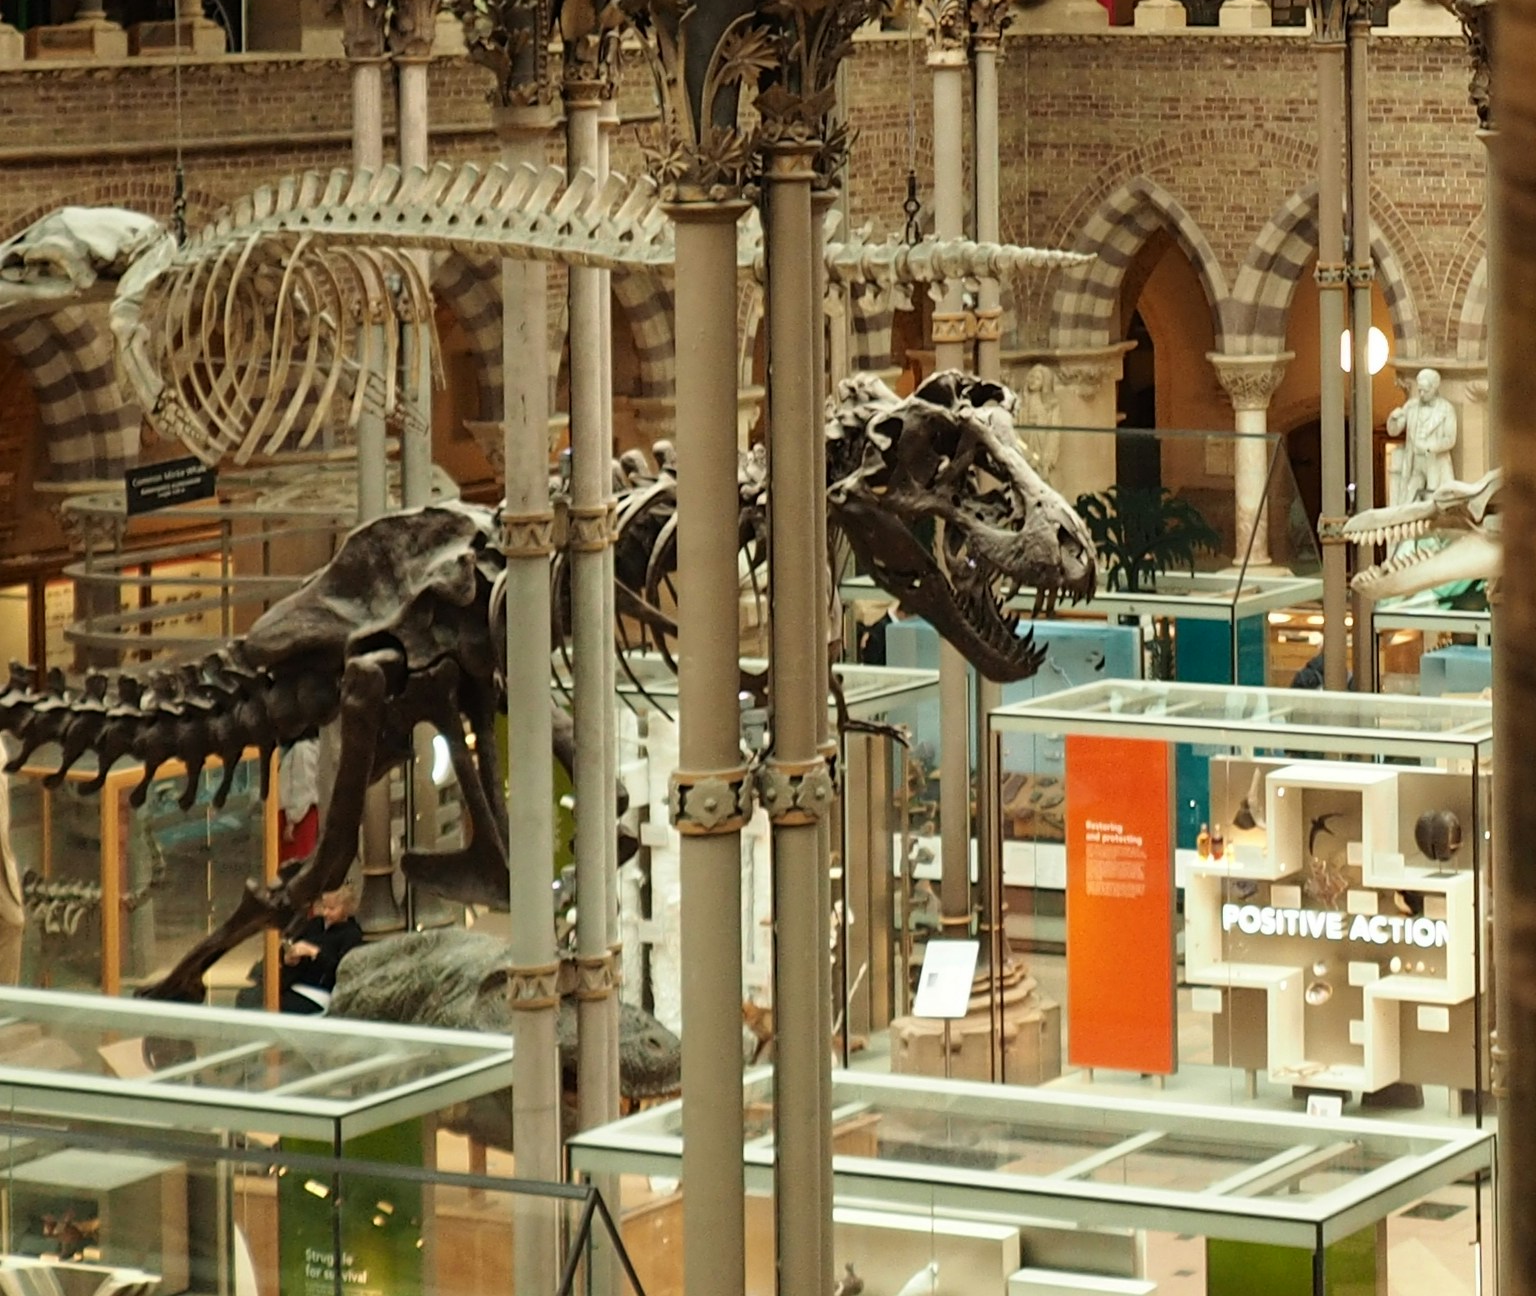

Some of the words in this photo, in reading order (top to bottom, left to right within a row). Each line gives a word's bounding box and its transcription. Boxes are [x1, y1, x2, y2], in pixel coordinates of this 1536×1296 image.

[1086, 820, 1124, 836] Restoring
[1086, 832, 1101, 843] and
[1102, 834, 1143, 848] protecting
[1223, 904, 1343, 941] POSITIVE
[1348, 914, 1449, 948] ACTION
[306, 1248, 354, 1267] Strugle
[306, 1264, 322, 1279] for
[323, 1269, 368, 1285] suvival
